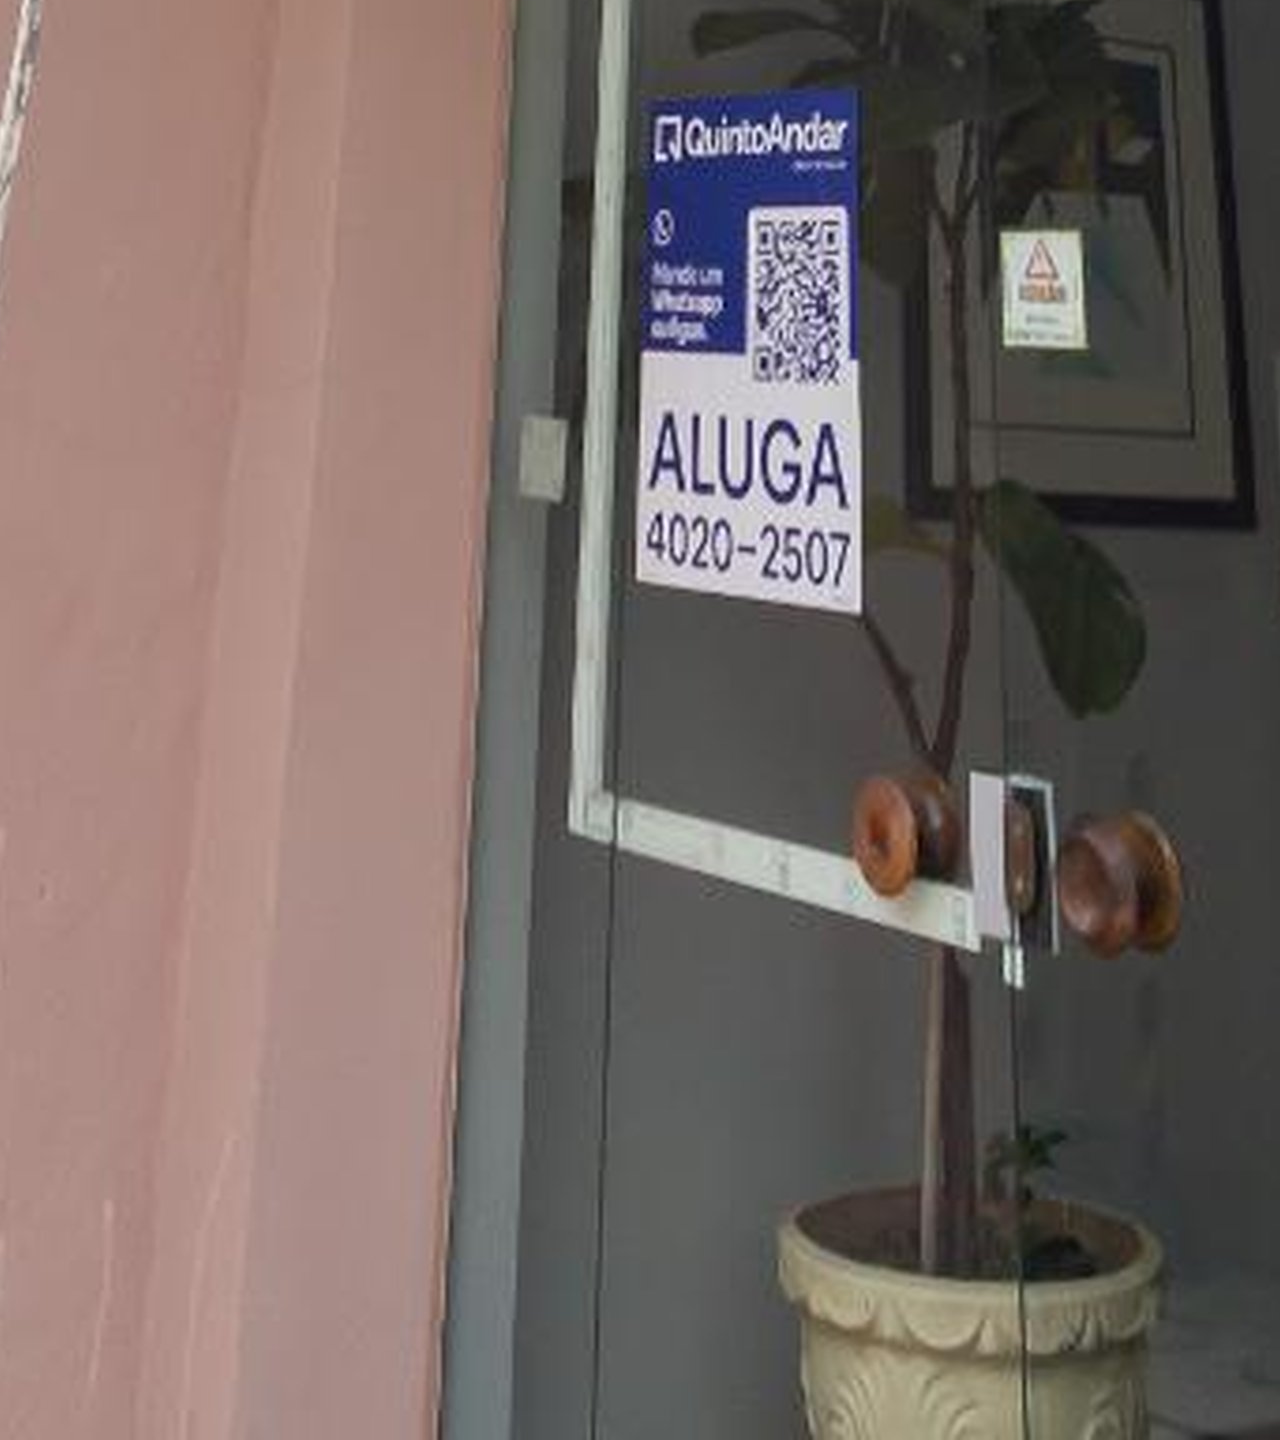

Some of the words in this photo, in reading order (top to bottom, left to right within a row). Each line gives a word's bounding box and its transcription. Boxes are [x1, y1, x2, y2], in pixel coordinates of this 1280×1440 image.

[683, 111, 849, 158] QuintoAndar
[648, 410, 850, 510] ALUGA
[646, 510, 851, 588] 4020-2507
